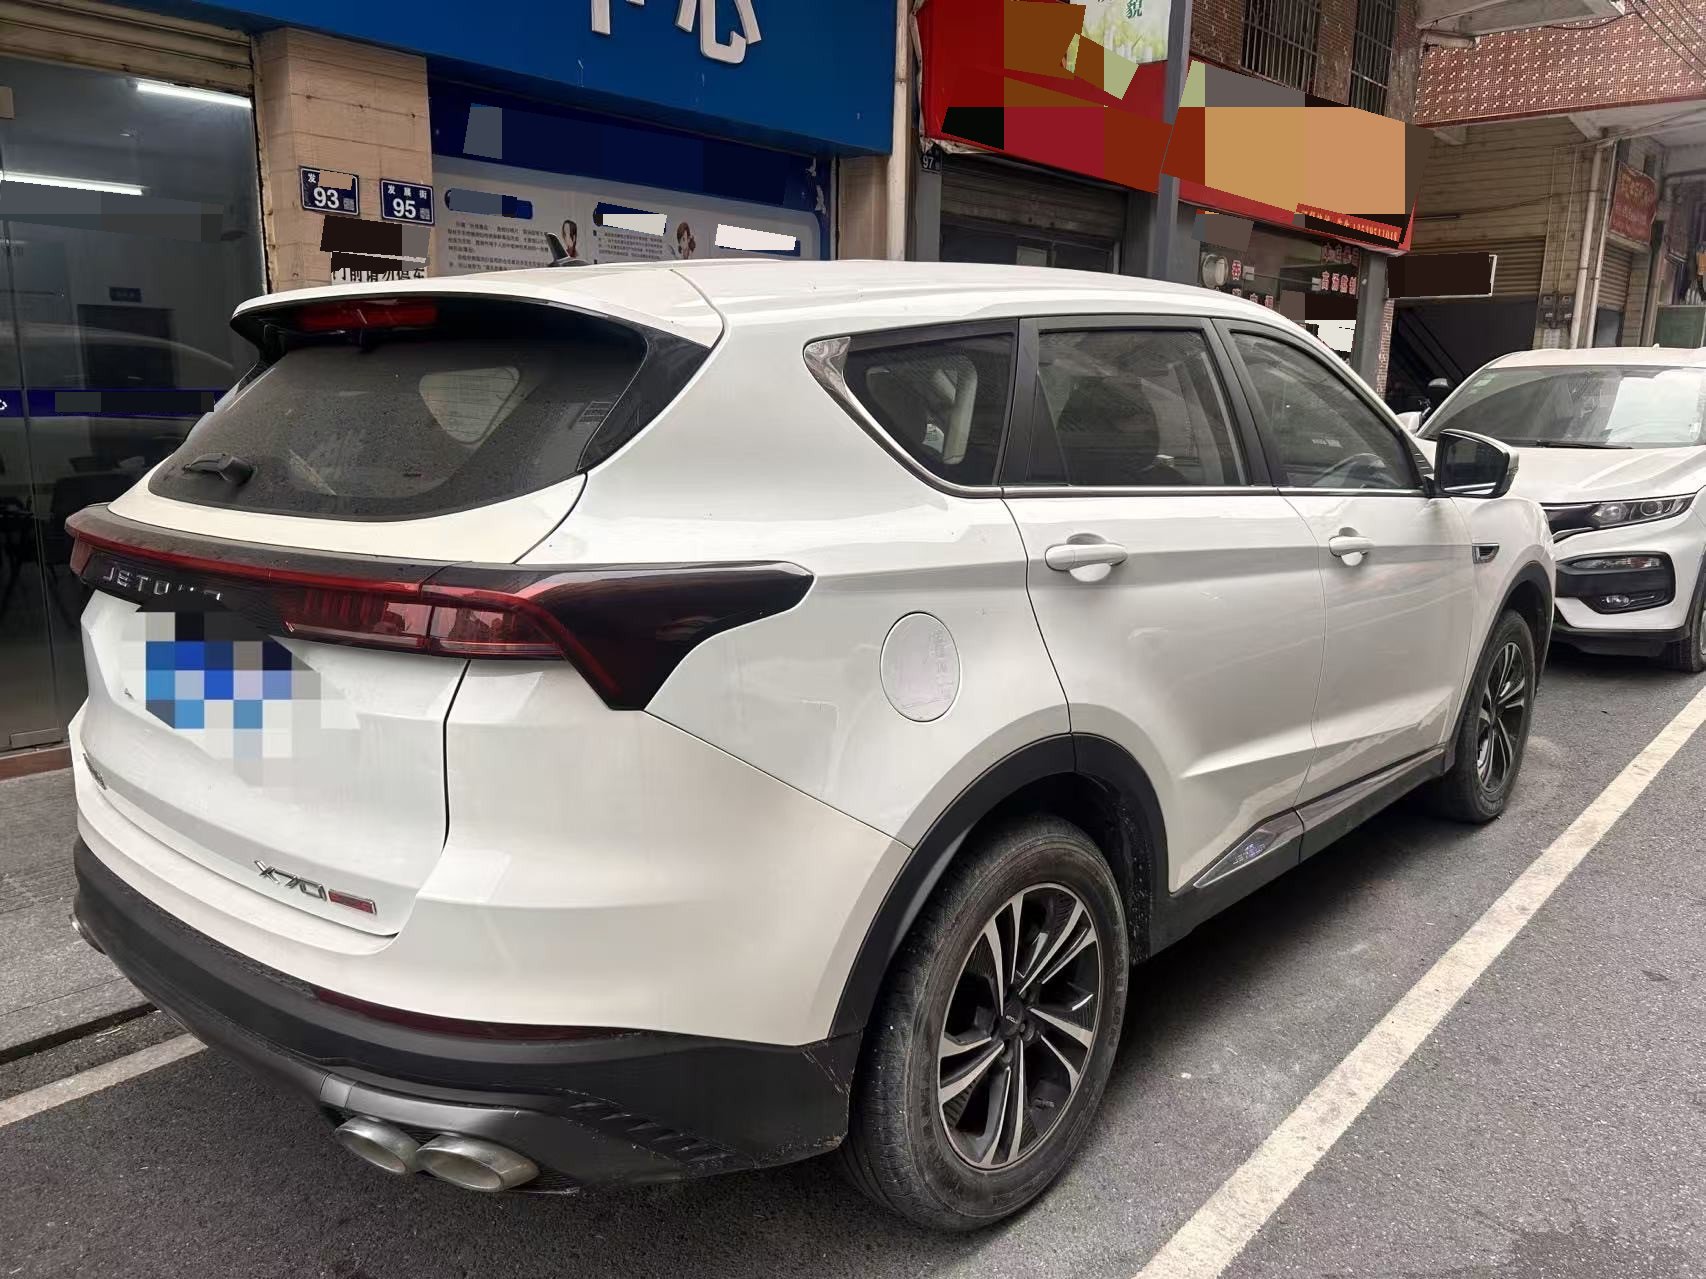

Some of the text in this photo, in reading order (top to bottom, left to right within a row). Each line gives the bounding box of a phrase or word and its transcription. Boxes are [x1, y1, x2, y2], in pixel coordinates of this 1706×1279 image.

[922, 155, 934, 169] 97
[313, 187, 340, 209] 93
[387, 184, 428, 200] 发展街
[393, 198, 417, 219] 95
[102, 567, 221, 601] JETO
[254, 860, 327, 902] X70
